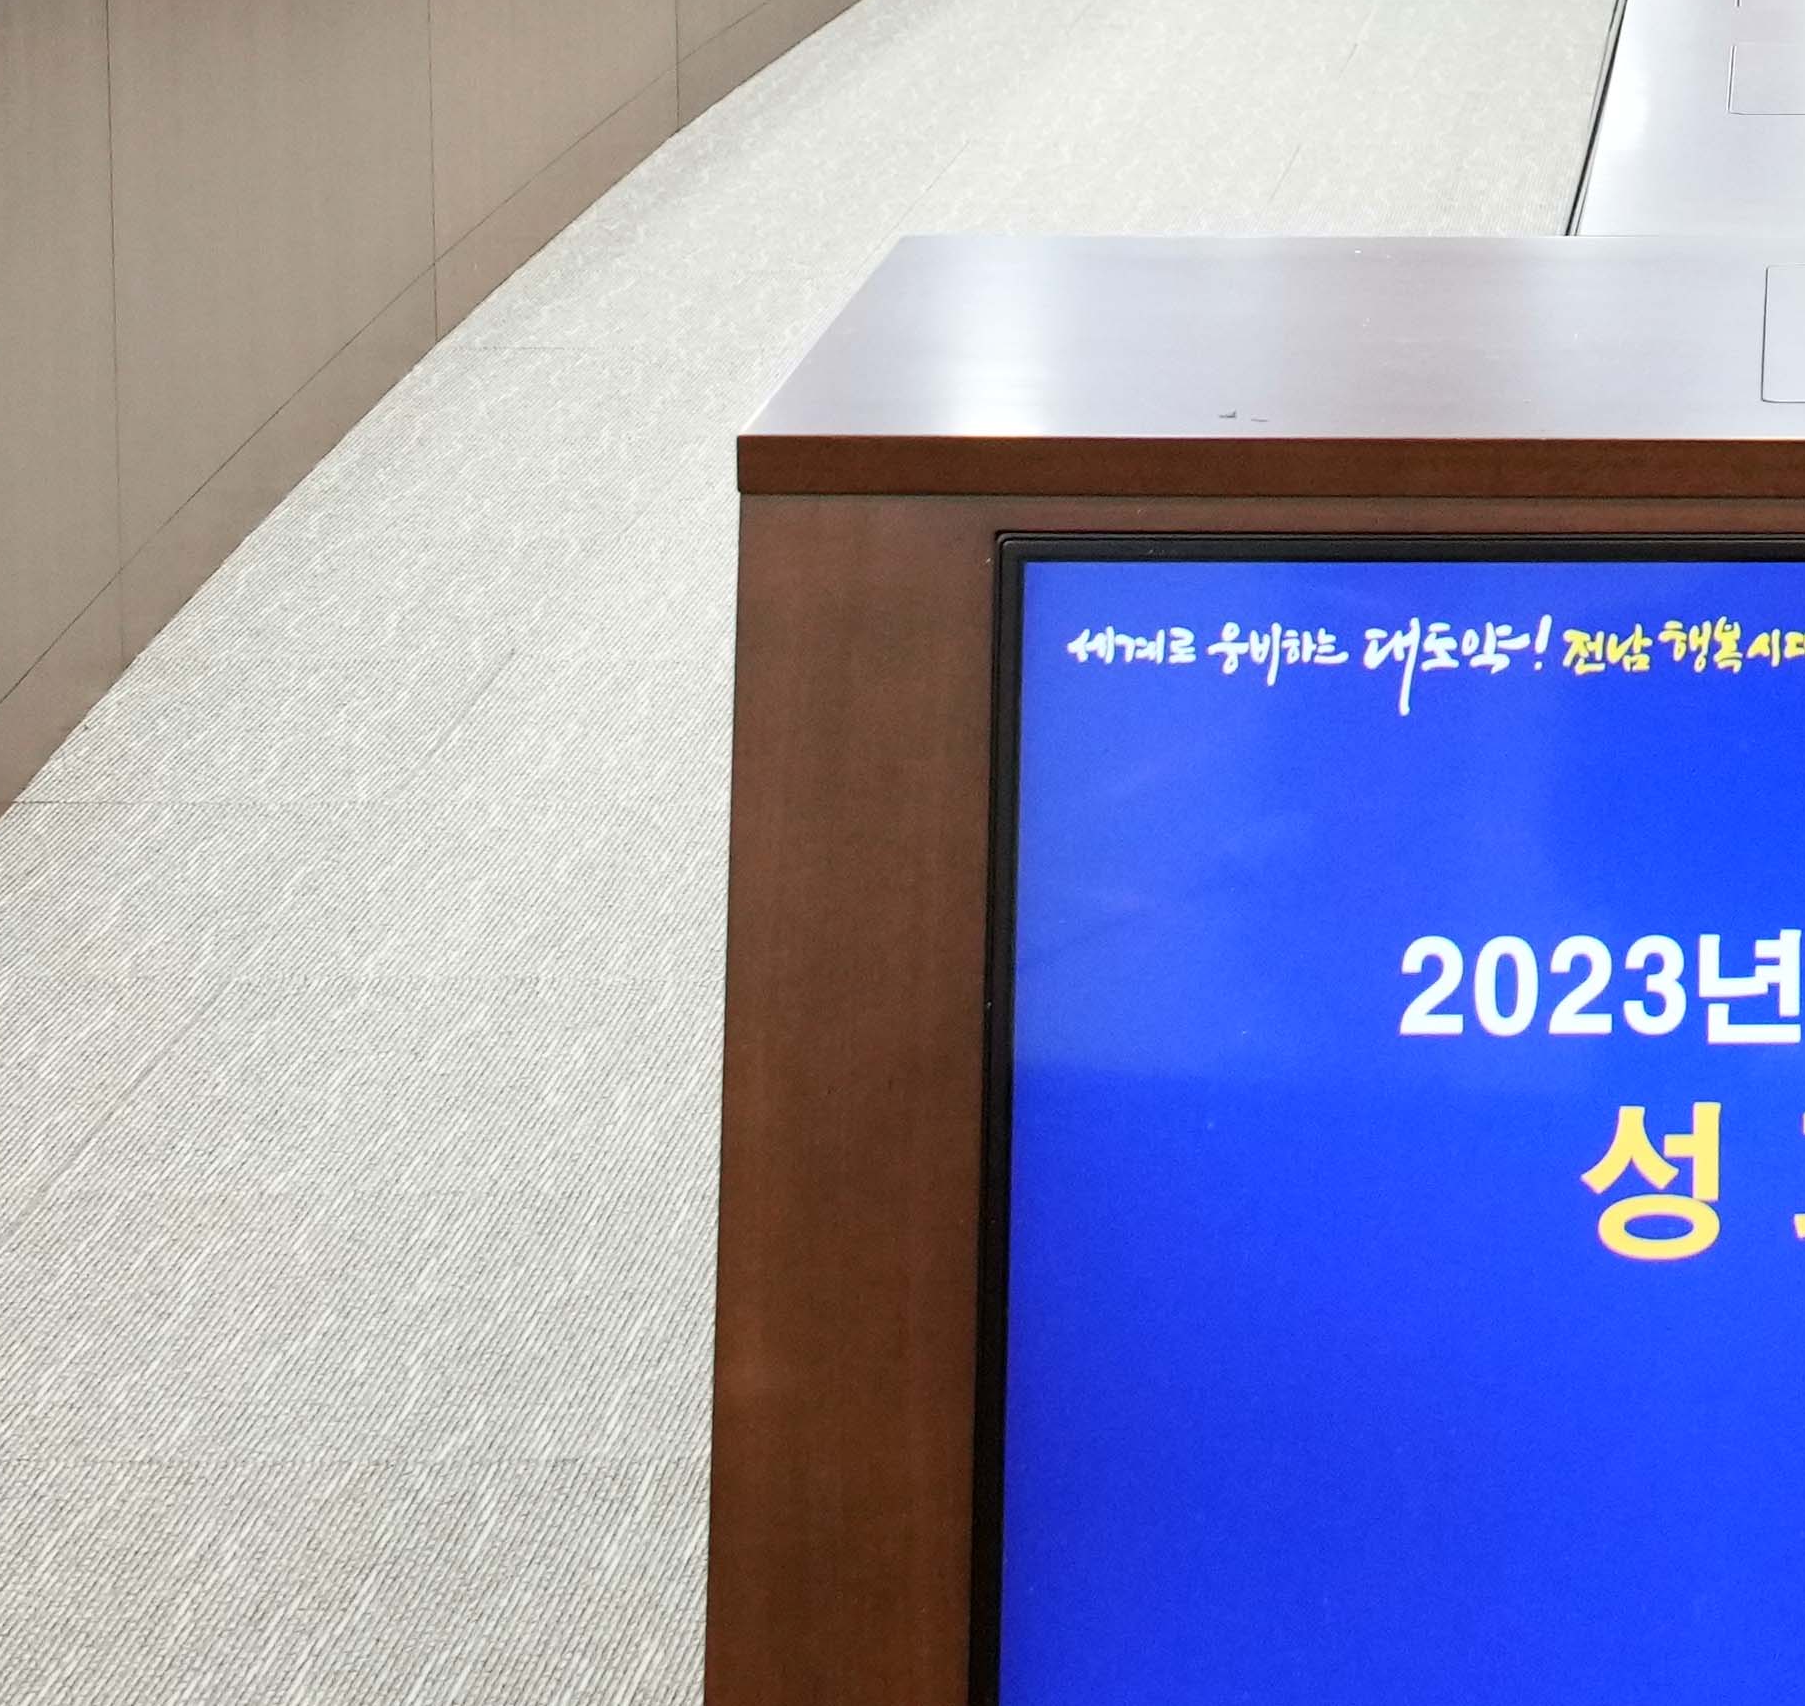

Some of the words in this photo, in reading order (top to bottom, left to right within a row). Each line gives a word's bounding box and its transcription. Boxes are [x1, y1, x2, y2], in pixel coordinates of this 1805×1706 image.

[1067, 625, 1196, 665] 세계로
[1206, 621, 1349, 685] 웅비하는
[1362, 615, 1553, 715] 대도약!
[1562, 623, 1653, 675] 전남
